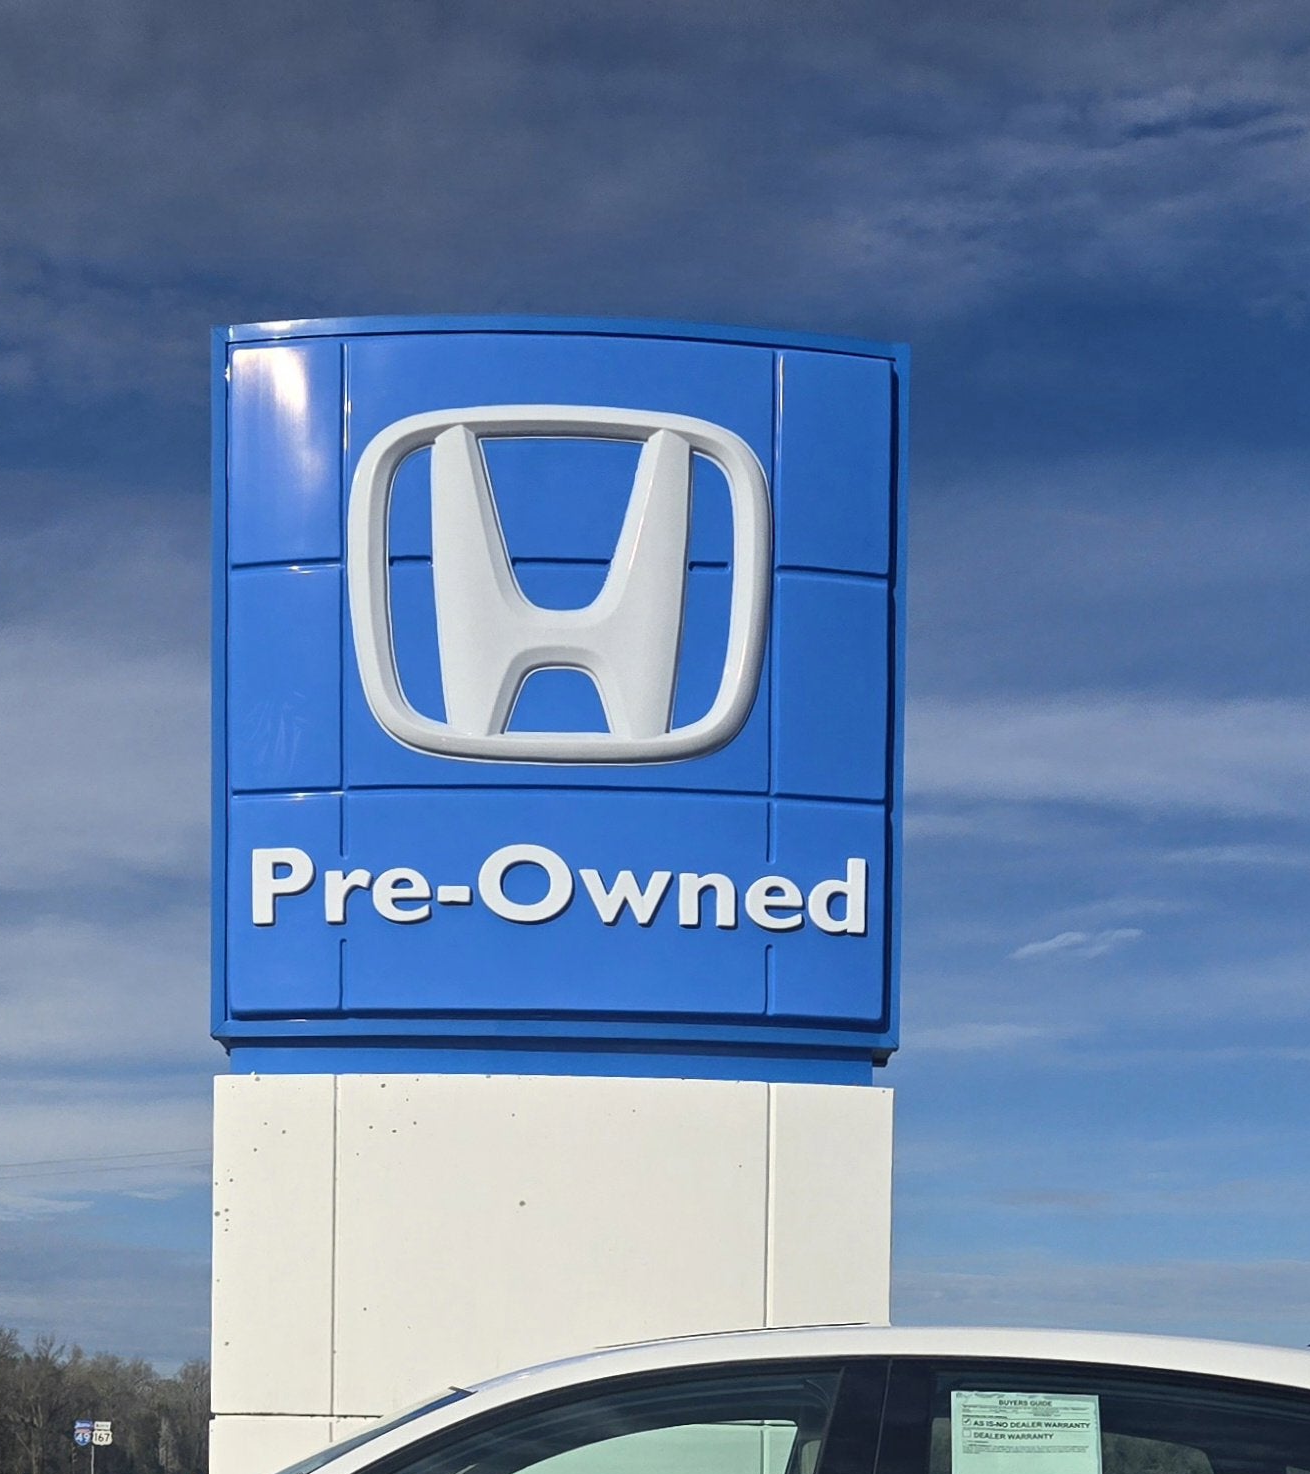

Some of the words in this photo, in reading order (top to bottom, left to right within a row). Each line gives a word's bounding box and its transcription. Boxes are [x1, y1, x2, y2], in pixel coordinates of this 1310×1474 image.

[251, 843, 867, 935] Pre-Owned
[1043, 1421, 1091, 1429] WARRANTY
[76, 1432, 91, 1443] 49
[94, 1432, 110, 1443] 167
[973, 1431, 1006, 1439] DEALER
[1007, 1432, 1054, 1440] WARRANTY
